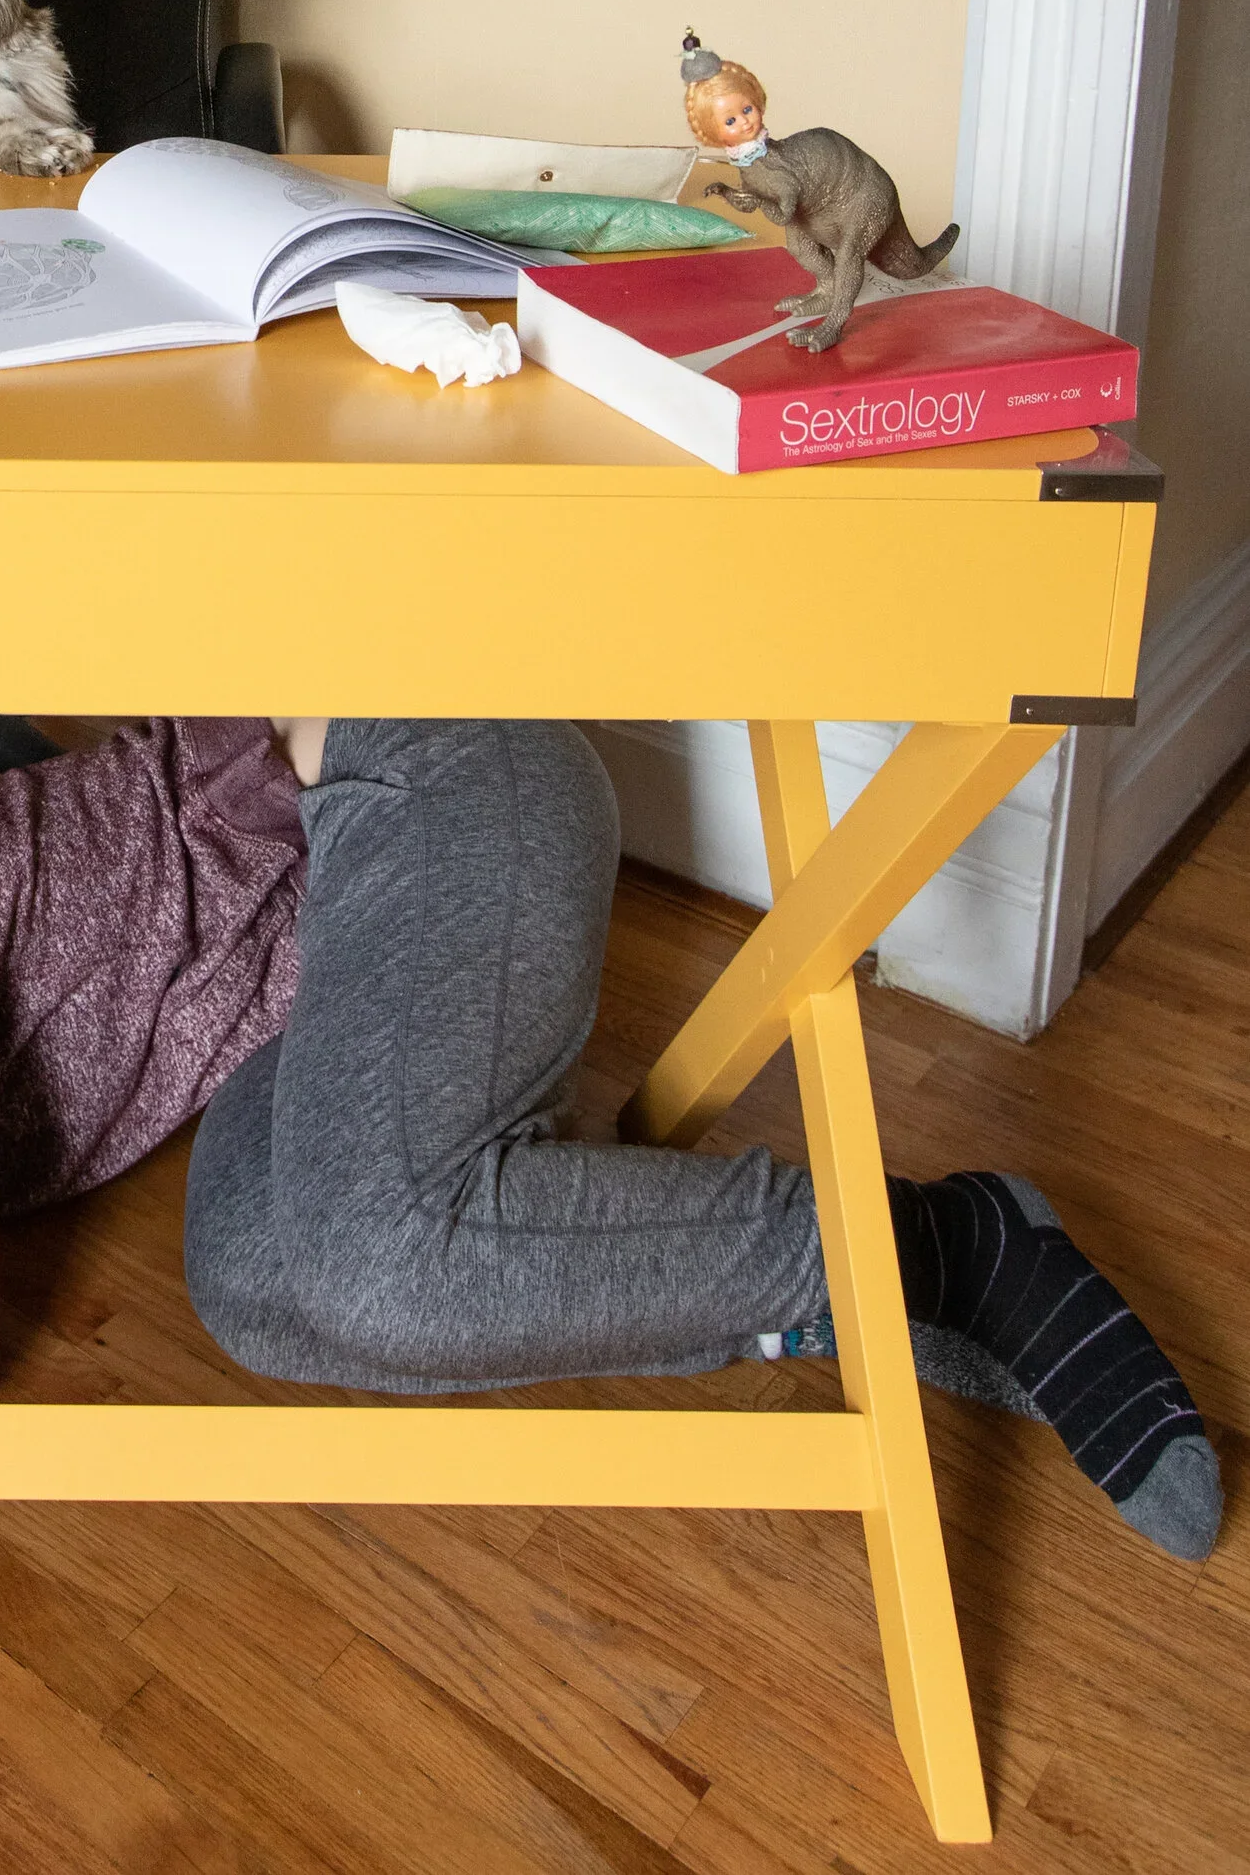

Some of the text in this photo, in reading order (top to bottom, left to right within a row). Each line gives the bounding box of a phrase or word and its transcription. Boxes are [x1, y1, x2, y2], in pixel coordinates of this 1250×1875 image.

[1006, 392, 1050, 407] STARSKY
[1060, 388, 1082, 400] COX
[1114, 376, 1122, 401] Collins
[780, 387, 986, 446] Sextrology
[783, 428, 938, 458] The Astrology of Sex and the Sexes
